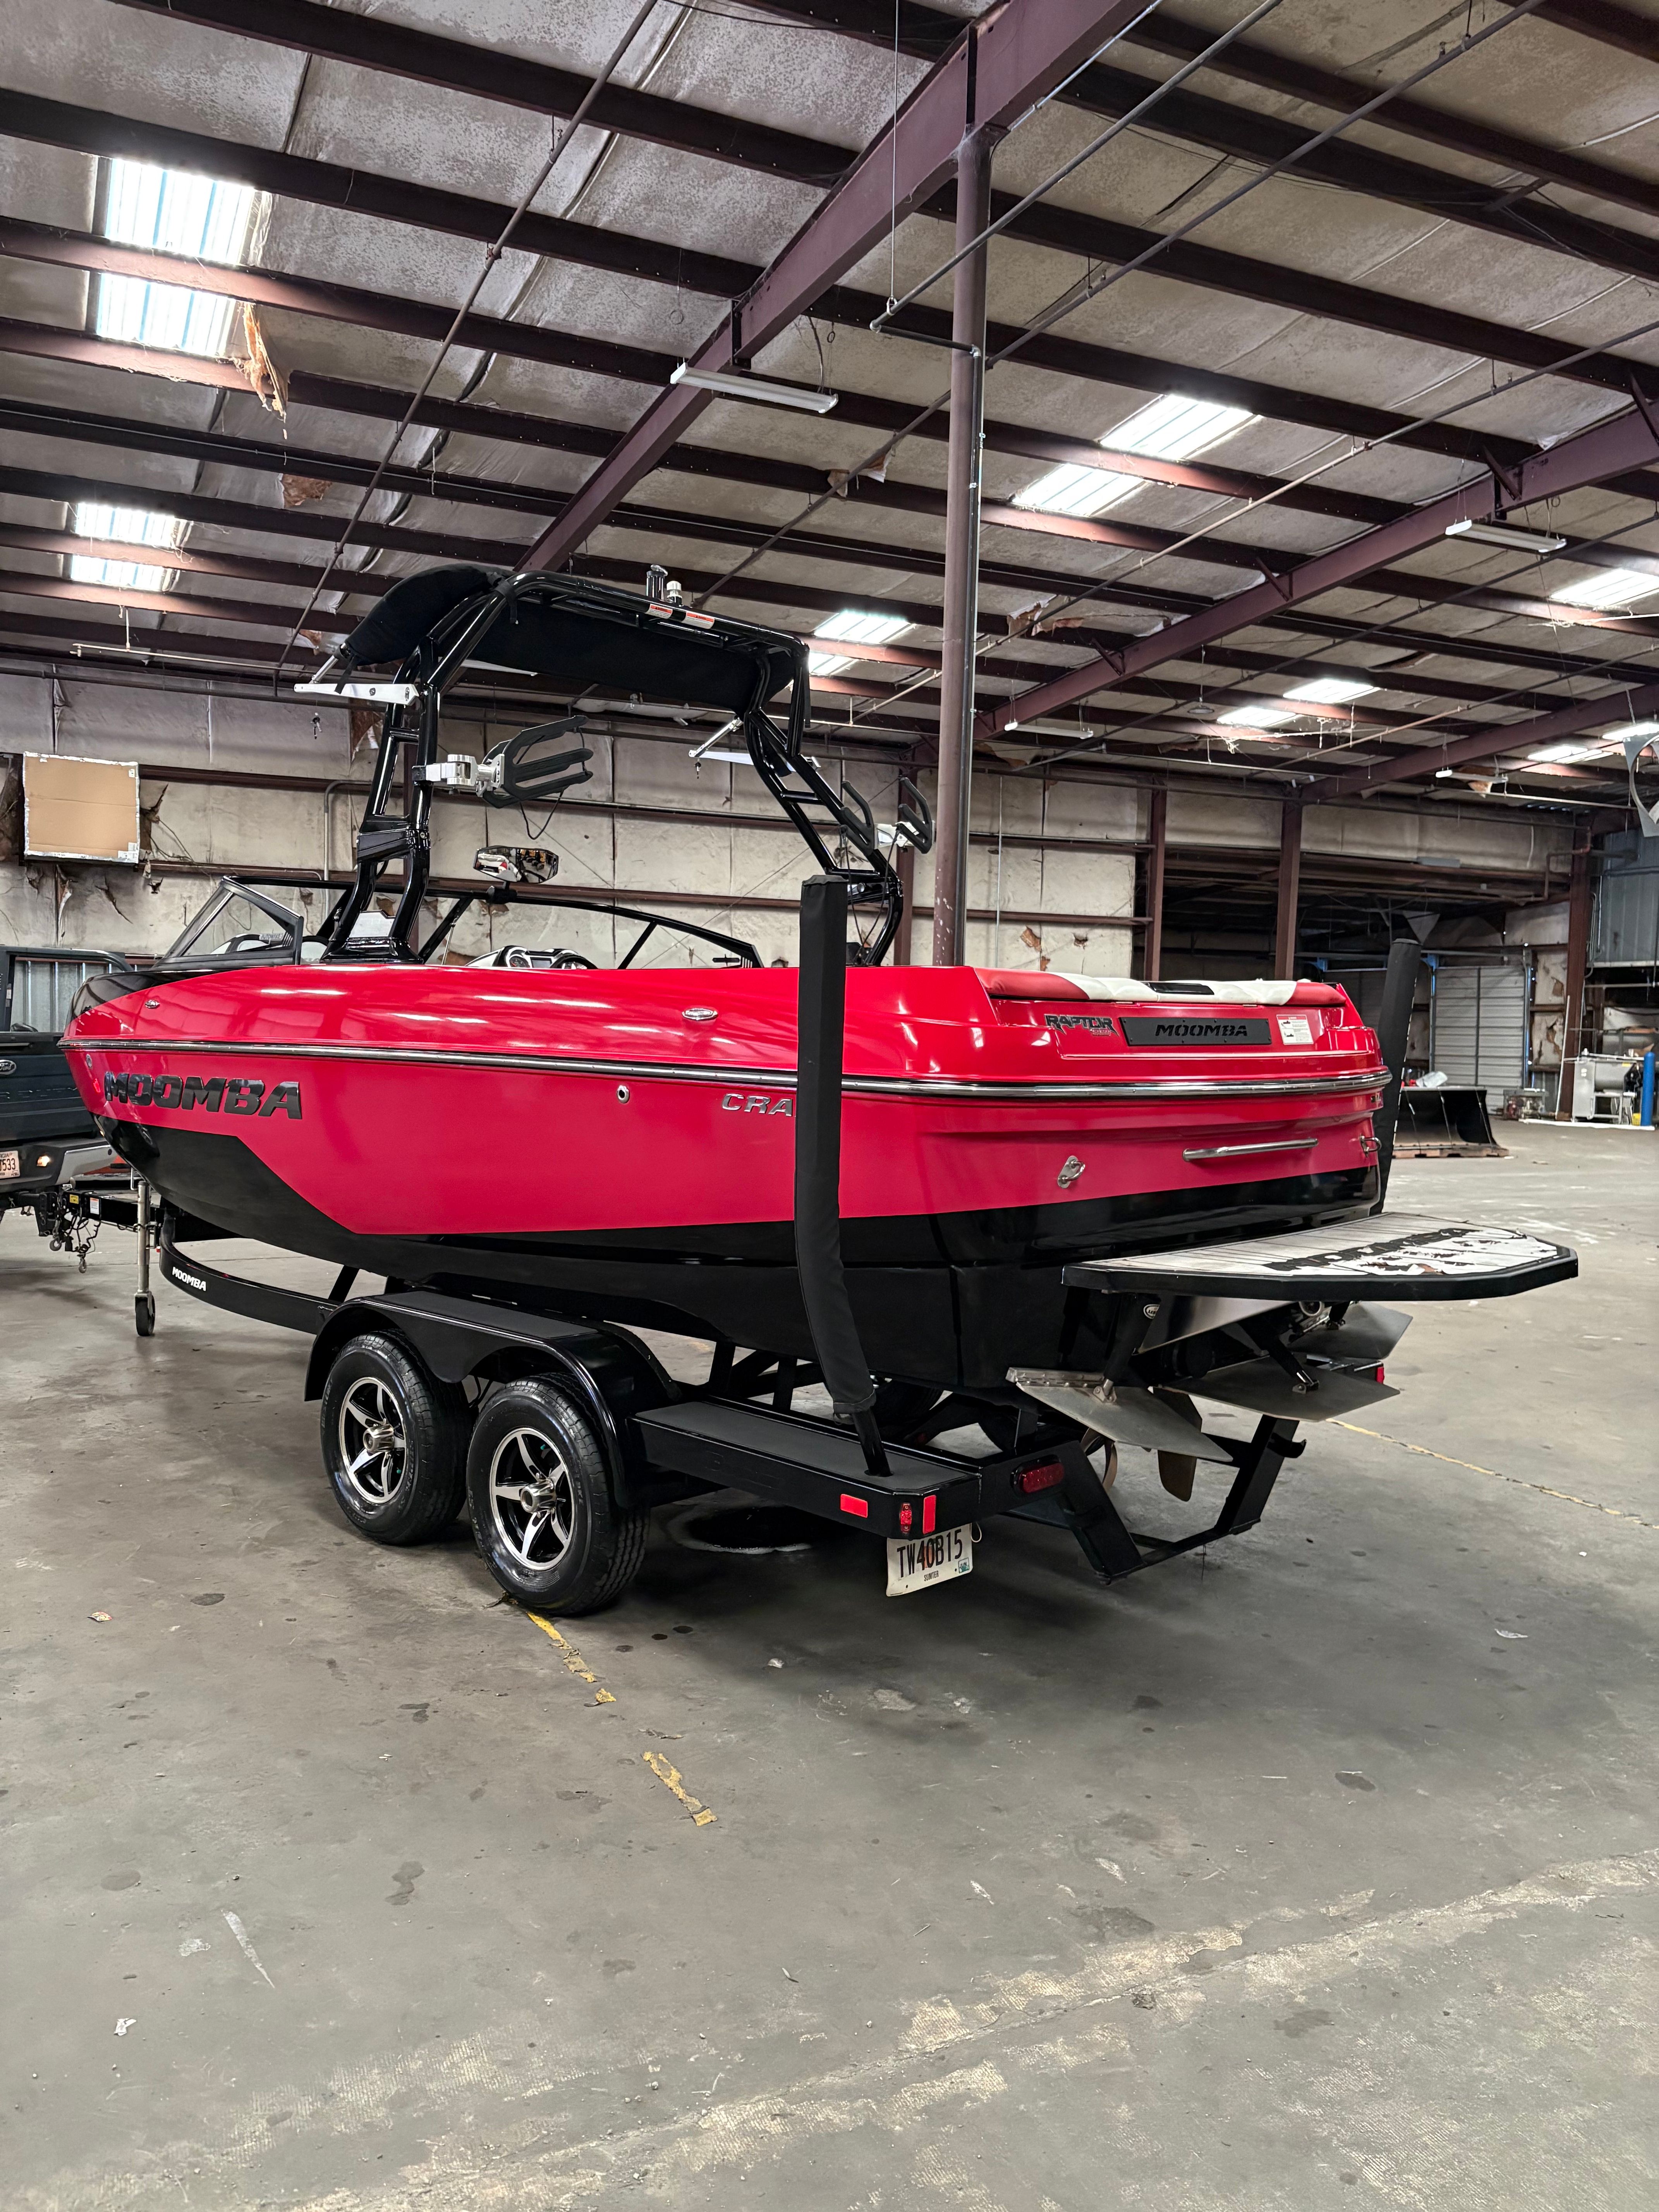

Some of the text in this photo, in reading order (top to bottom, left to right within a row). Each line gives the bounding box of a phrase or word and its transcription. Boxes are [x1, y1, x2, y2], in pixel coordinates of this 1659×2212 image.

[1044, 1014, 1120, 1037] RAPTOR
[1155, 1025, 1247, 1036] MOOMBA
[104, 1071, 302, 1120] MOOMBA
[722, 1093, 796, 1116] CRA
[172, 1266, 206, 1291] MOOMBA
[897, 1528, 962, 1578] TW40B15
[924, 1570, 939, 1582] SUMTER
